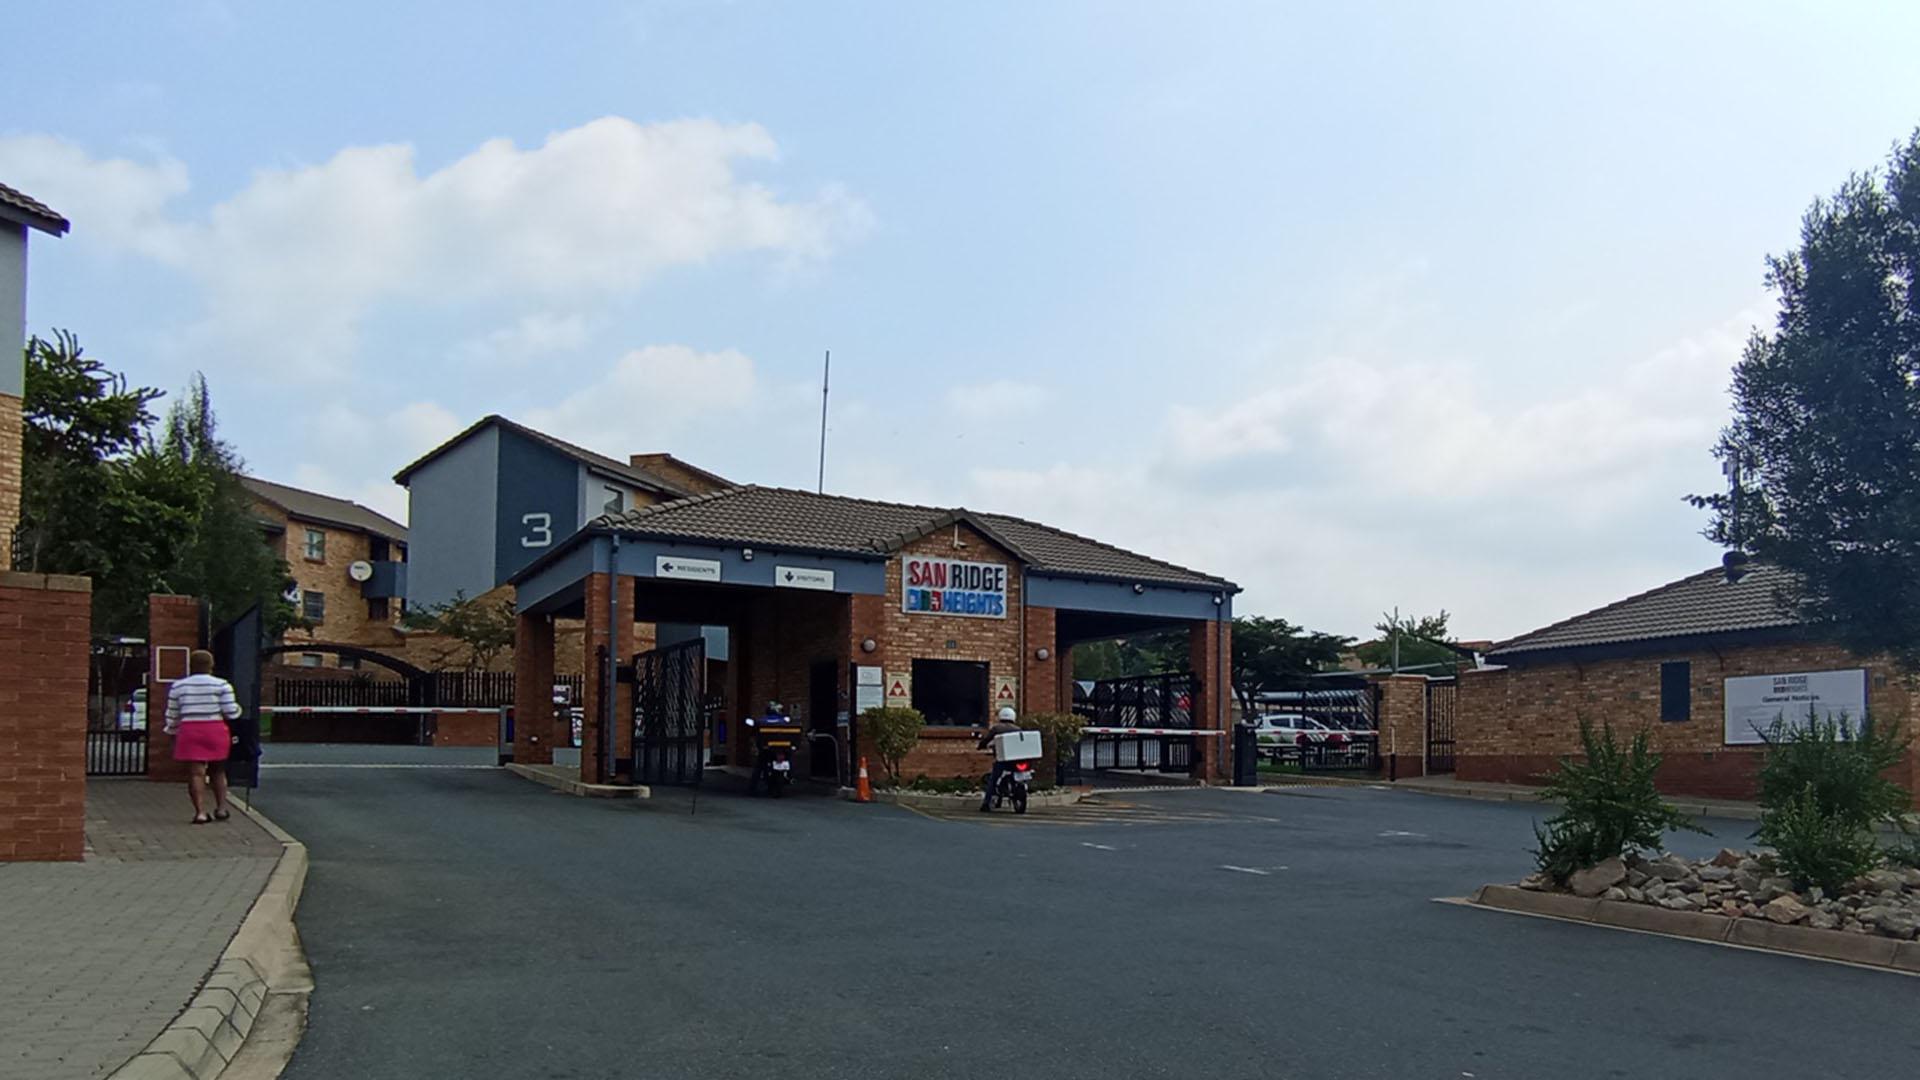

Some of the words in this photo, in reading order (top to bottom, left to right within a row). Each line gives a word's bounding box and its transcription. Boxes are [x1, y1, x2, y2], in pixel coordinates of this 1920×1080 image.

[521, 513, 552, 547] 3
[677, 564, 716, 575] RESIDENTS
[909, 560, 947, 586] SAN
[951, 564, 1004, 592] RIDGE
[942, 591, 1004, 616] HEIGHTS
